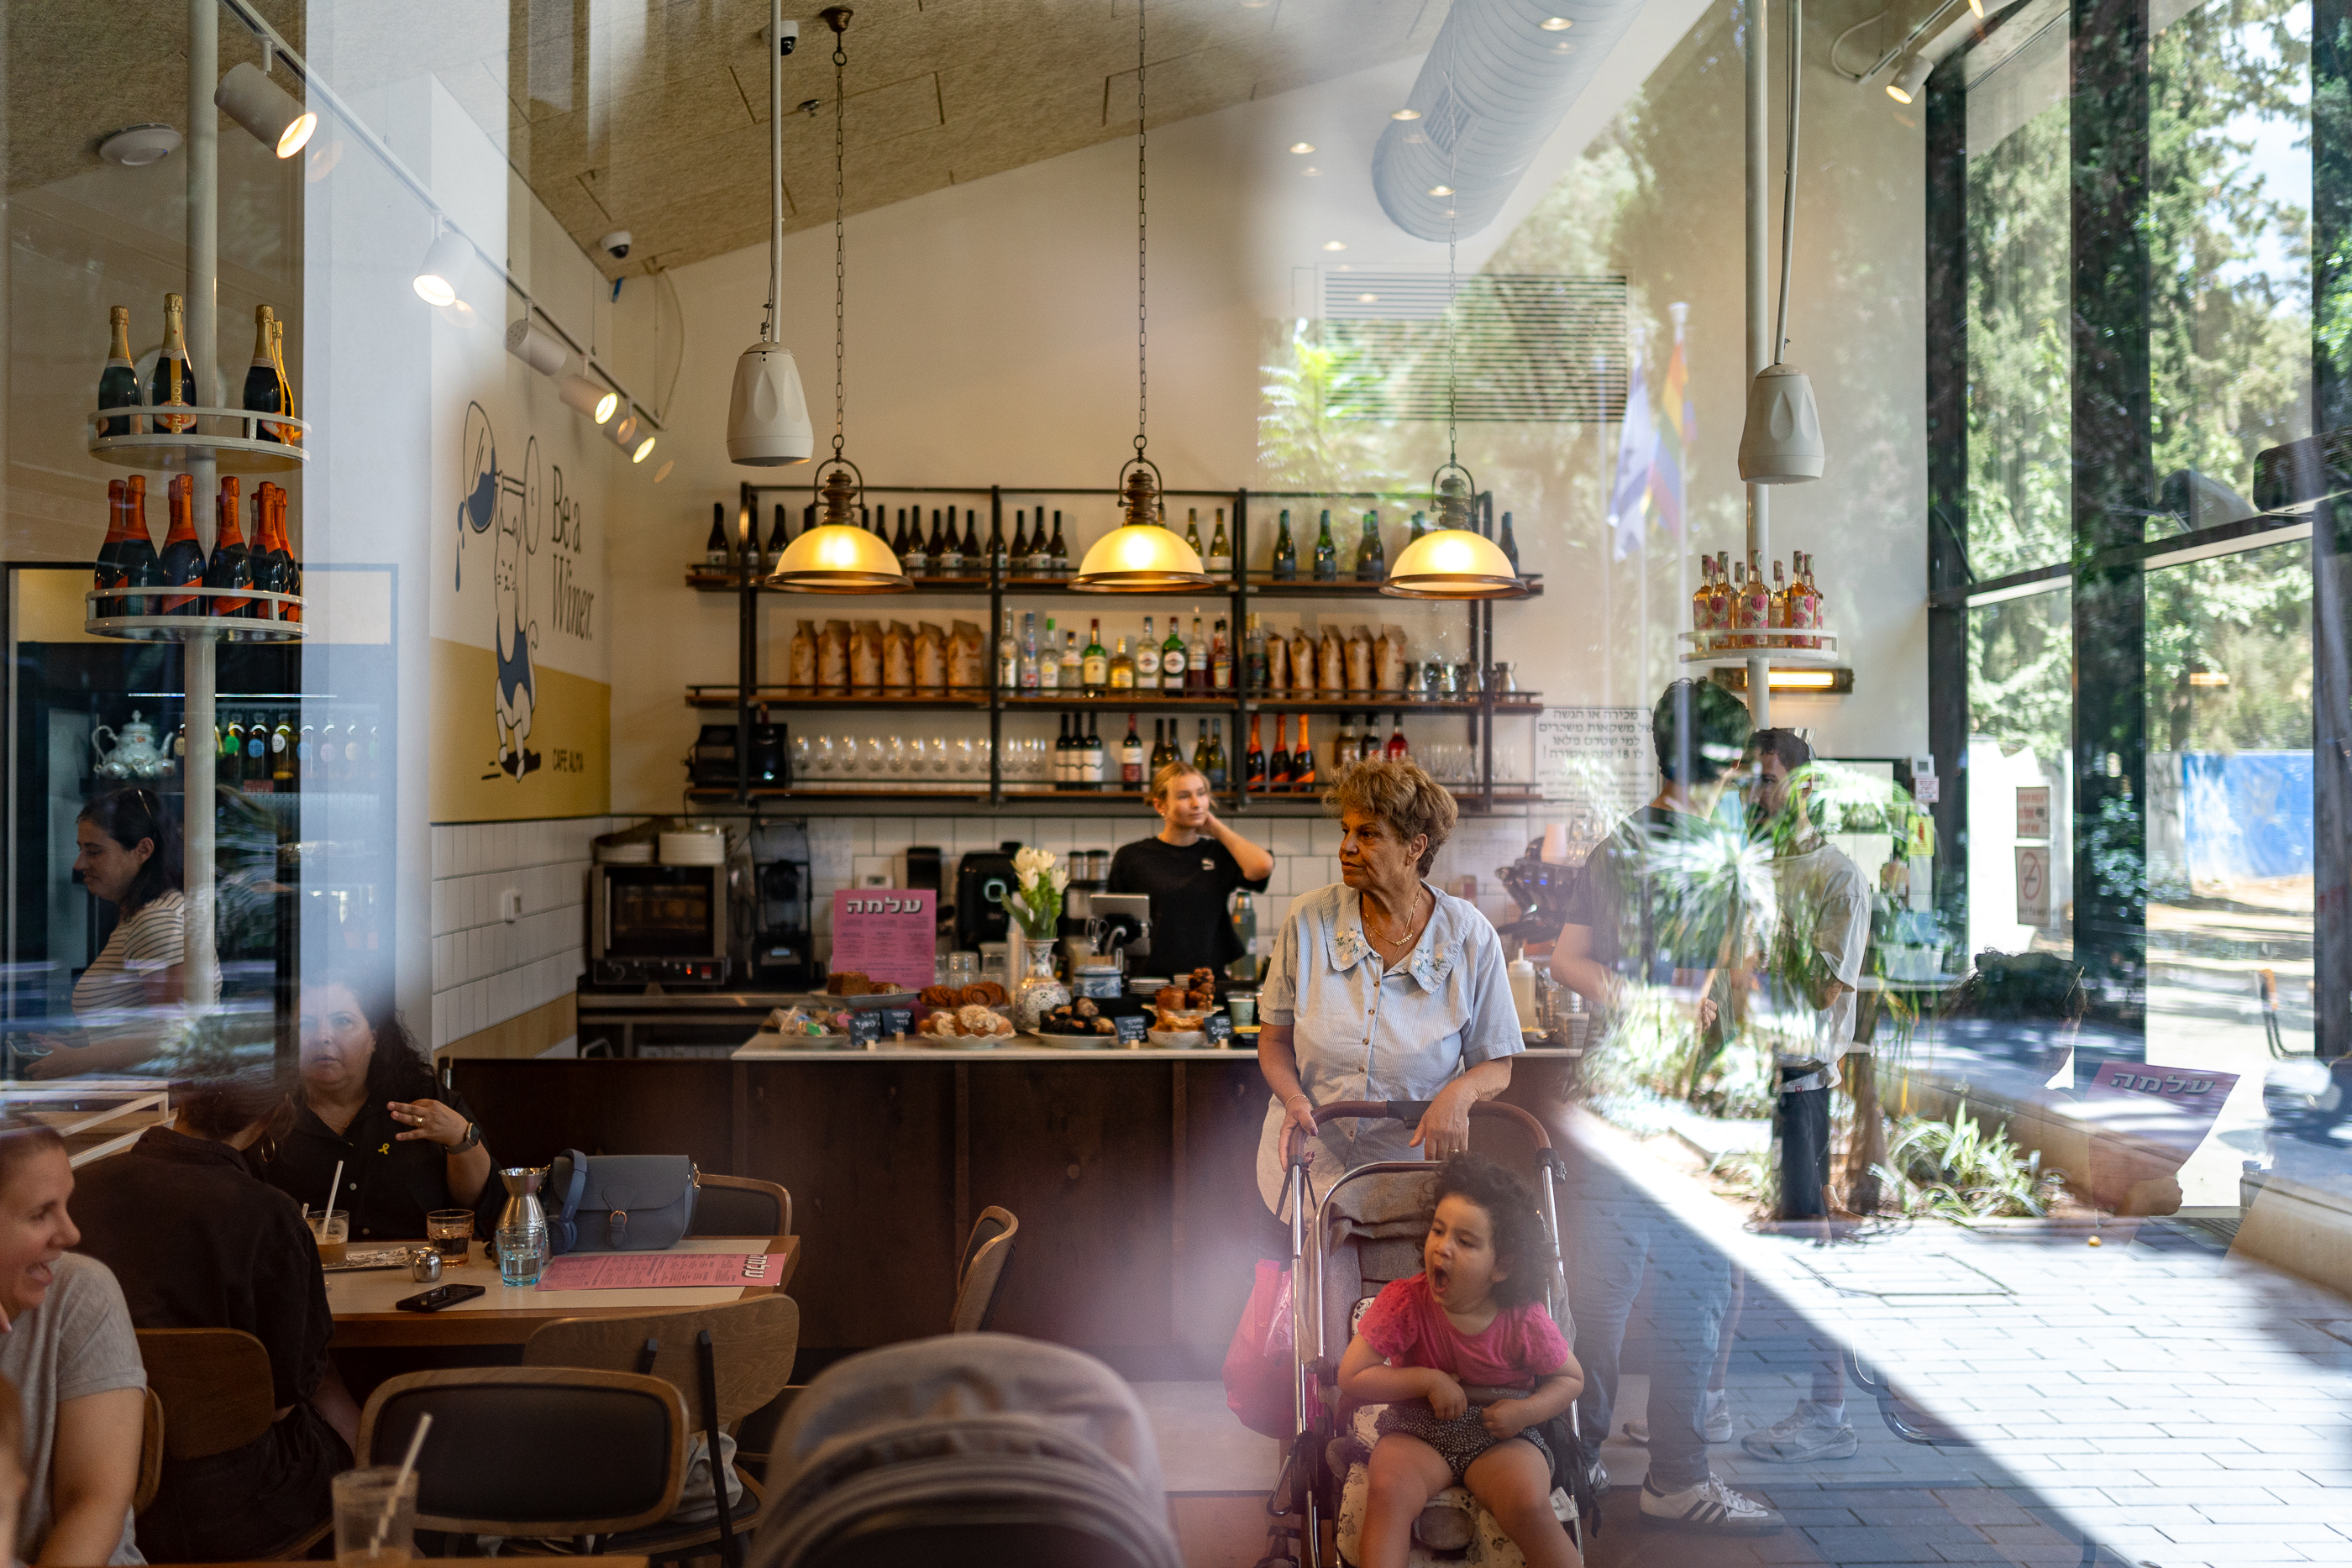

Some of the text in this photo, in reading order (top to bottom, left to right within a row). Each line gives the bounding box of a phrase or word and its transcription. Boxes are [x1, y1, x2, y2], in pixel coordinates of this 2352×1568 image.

[552, 464, 581, 554] Be a
[1553, 710, 1639, 720] מכירה או הגשה
[1587, 723, 1635, 734] משקאות
[1552, 735, 1641, 747] למי שטרם מלאו
[1617, 748, 1629, 759] 18
[846, 895, 923, 915] עלמה
[2110, 1072, 2215, 1095] עלמה
